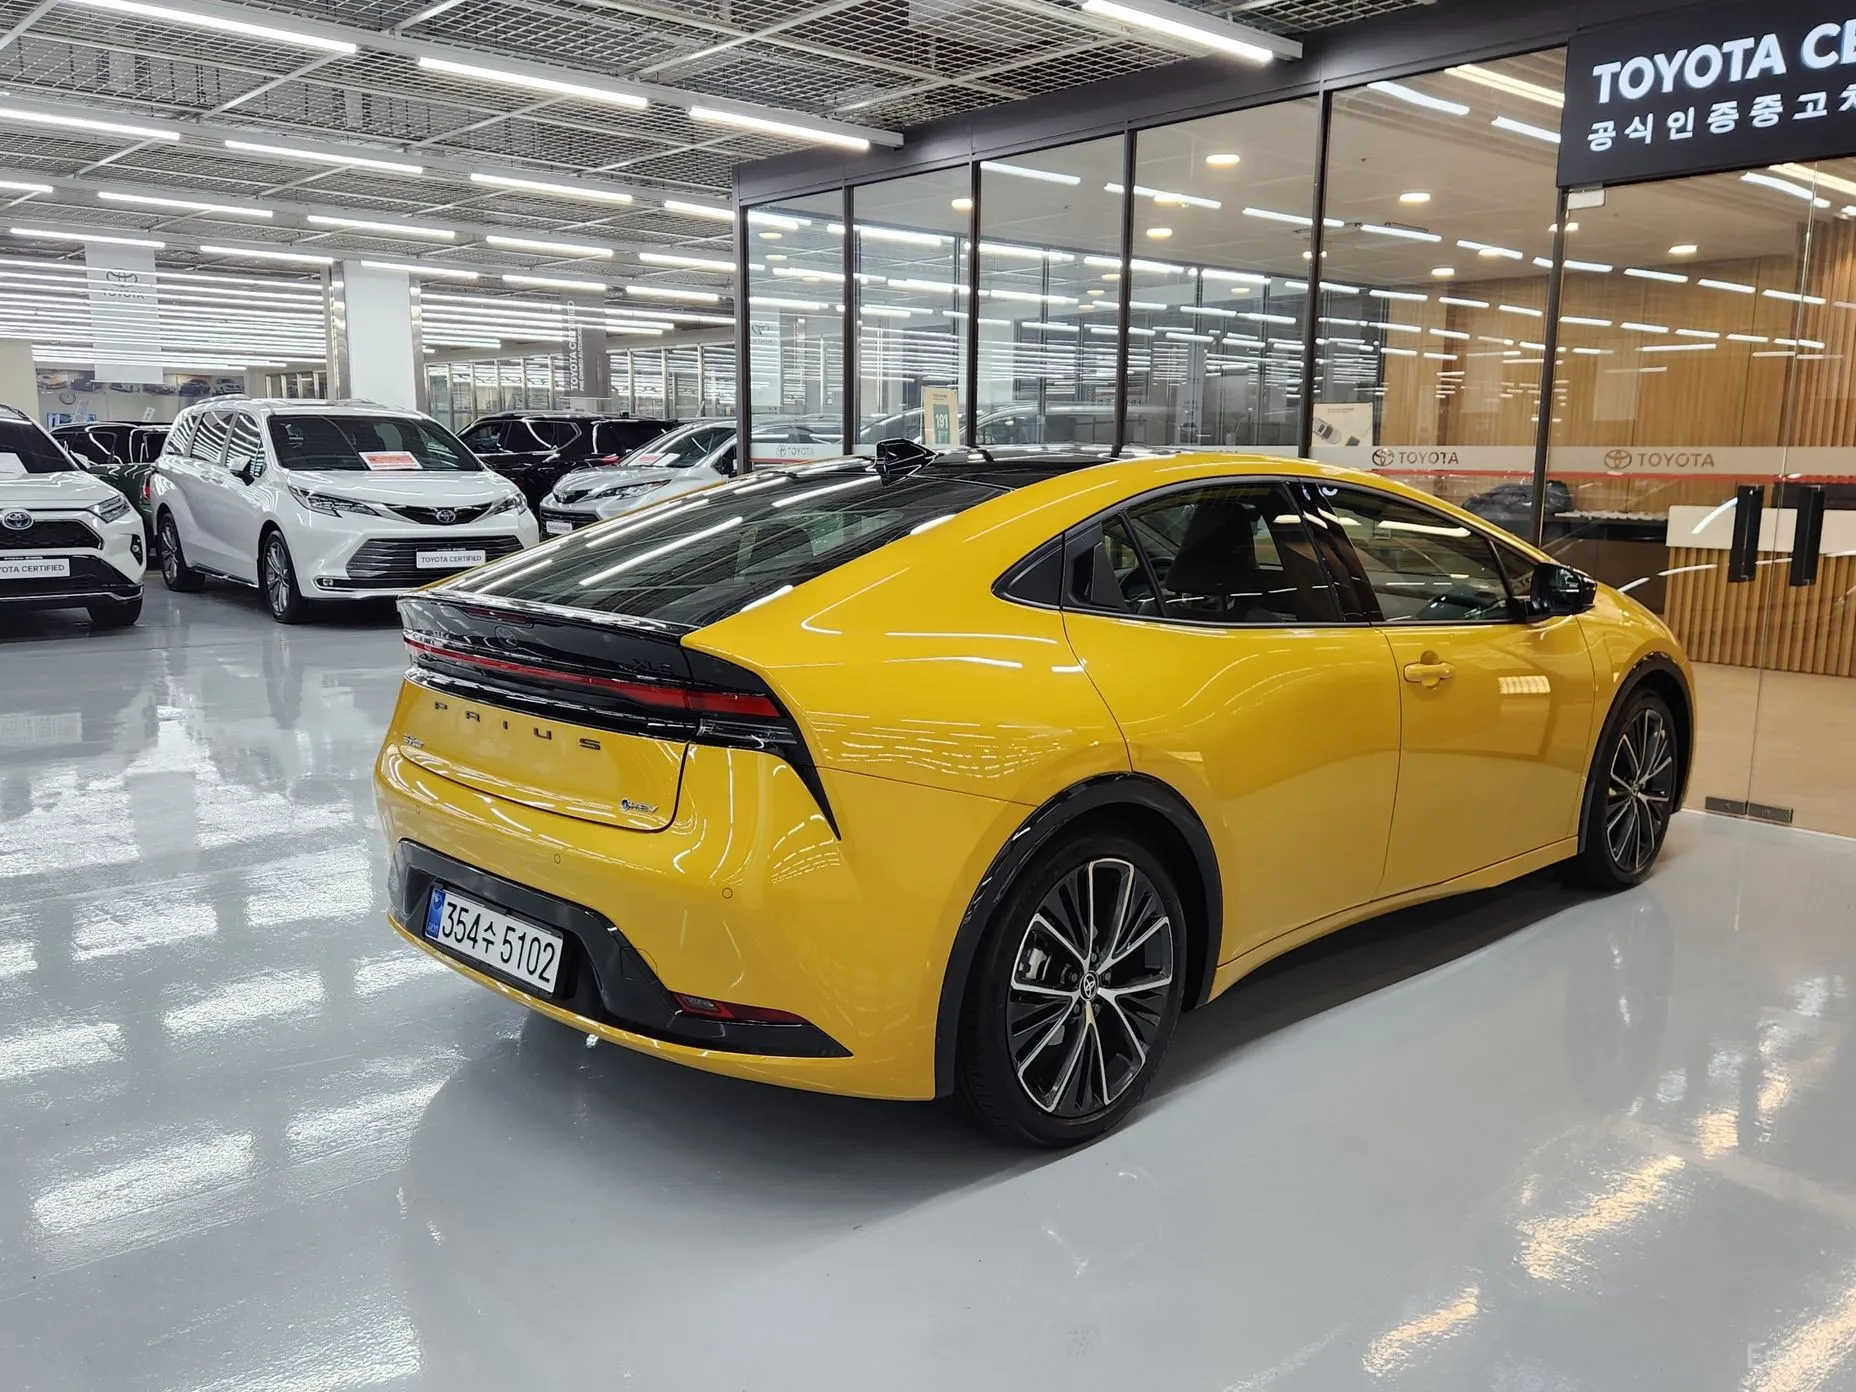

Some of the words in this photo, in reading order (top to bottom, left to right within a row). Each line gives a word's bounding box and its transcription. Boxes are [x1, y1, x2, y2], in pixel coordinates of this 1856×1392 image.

[1592, 33, 1787, 104] TOYOTA
[569, 351, 578, 391] TOYOTA
[935, 413, 948, 429] 191
[787, 446, 815, 457] TOYOTA
[1398, 451, 1460, 465] TOYOTA
[1637, 452, 1715, 467] TOYOTA
[449, 555, 482, 563] CERTIFIED
[21, 564, 65, 573] CERTIFIED
[500, 925, 556, 984] 5102
